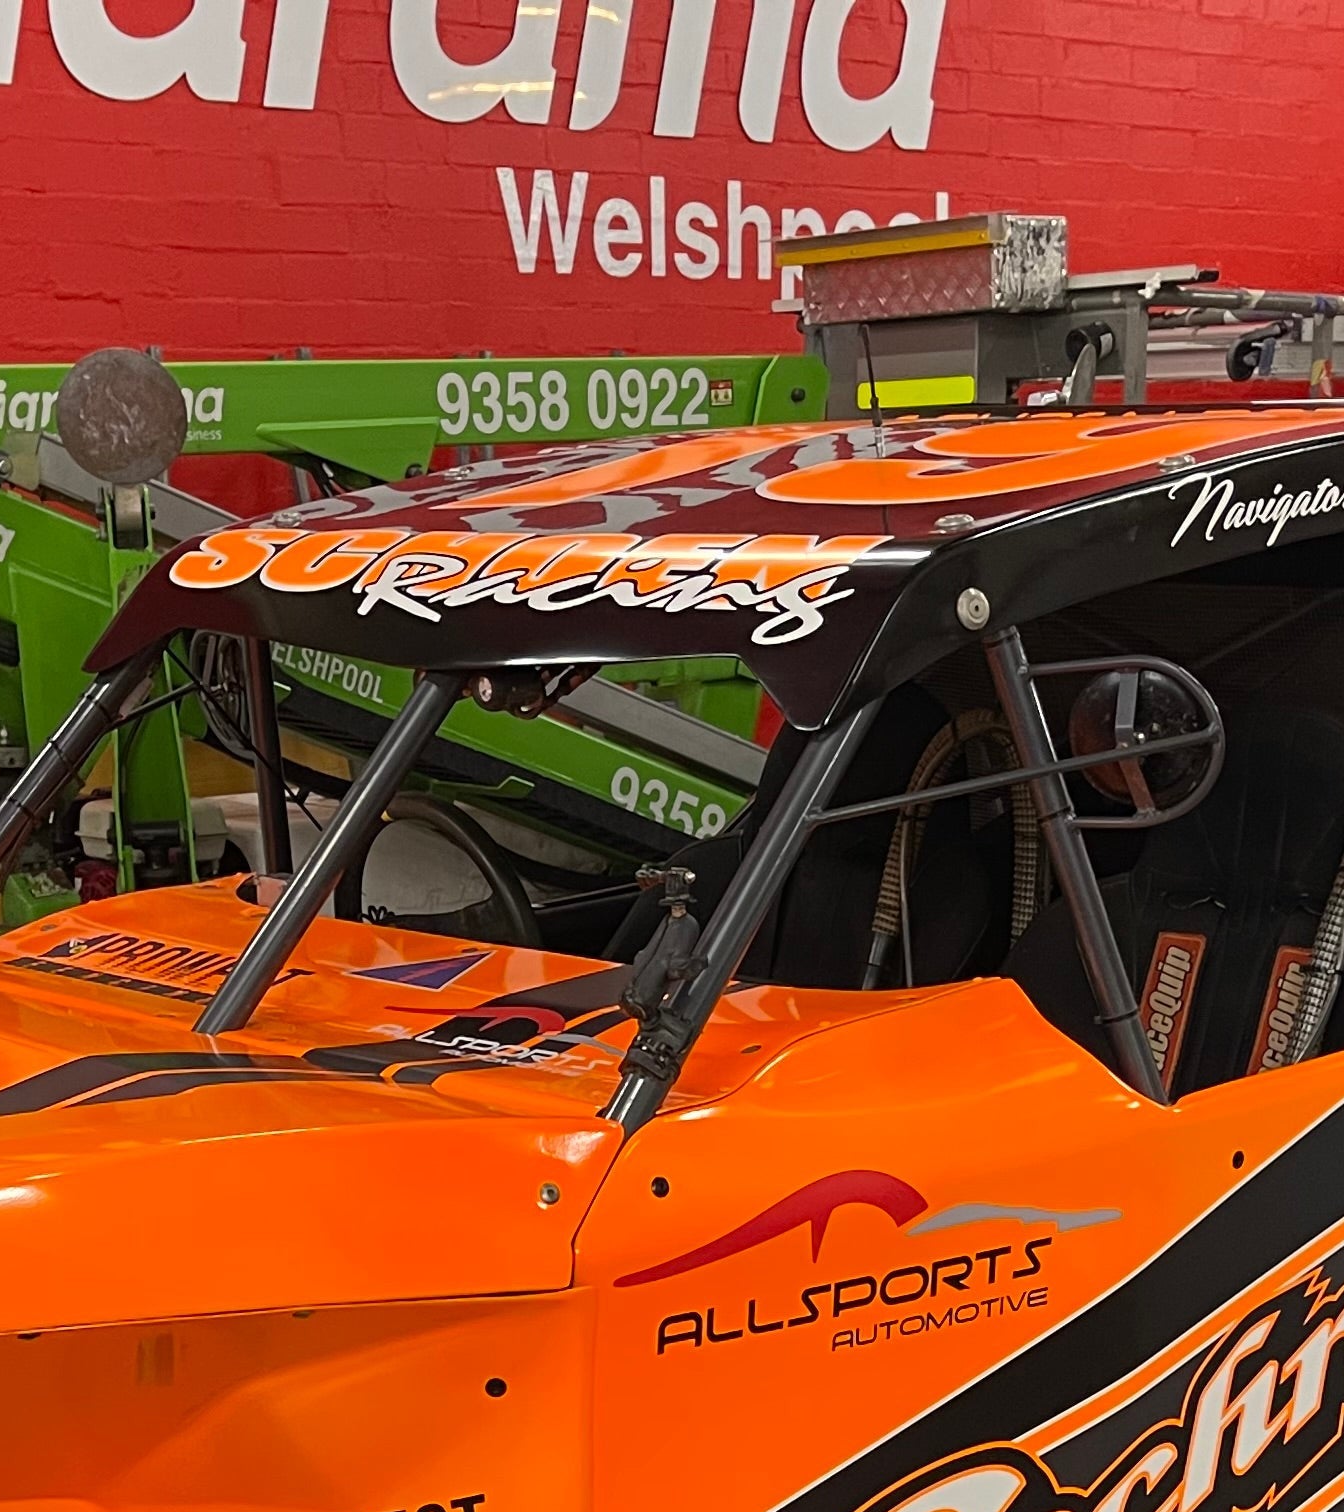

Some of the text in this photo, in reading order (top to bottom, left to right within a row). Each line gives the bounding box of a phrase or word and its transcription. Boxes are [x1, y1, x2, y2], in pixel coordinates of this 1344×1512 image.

[496, 166, 950, 301] Welshp
[436, 367, 710, 435] 9358 0922
[357, 552, 856, 645] Racing
[269, 640, 384, 704] ELSHPOOL
[657, 1236, 1053, 1355] ALLSPORTS
[831, 1286, 1049, 1352] AUTOMOTIVE
